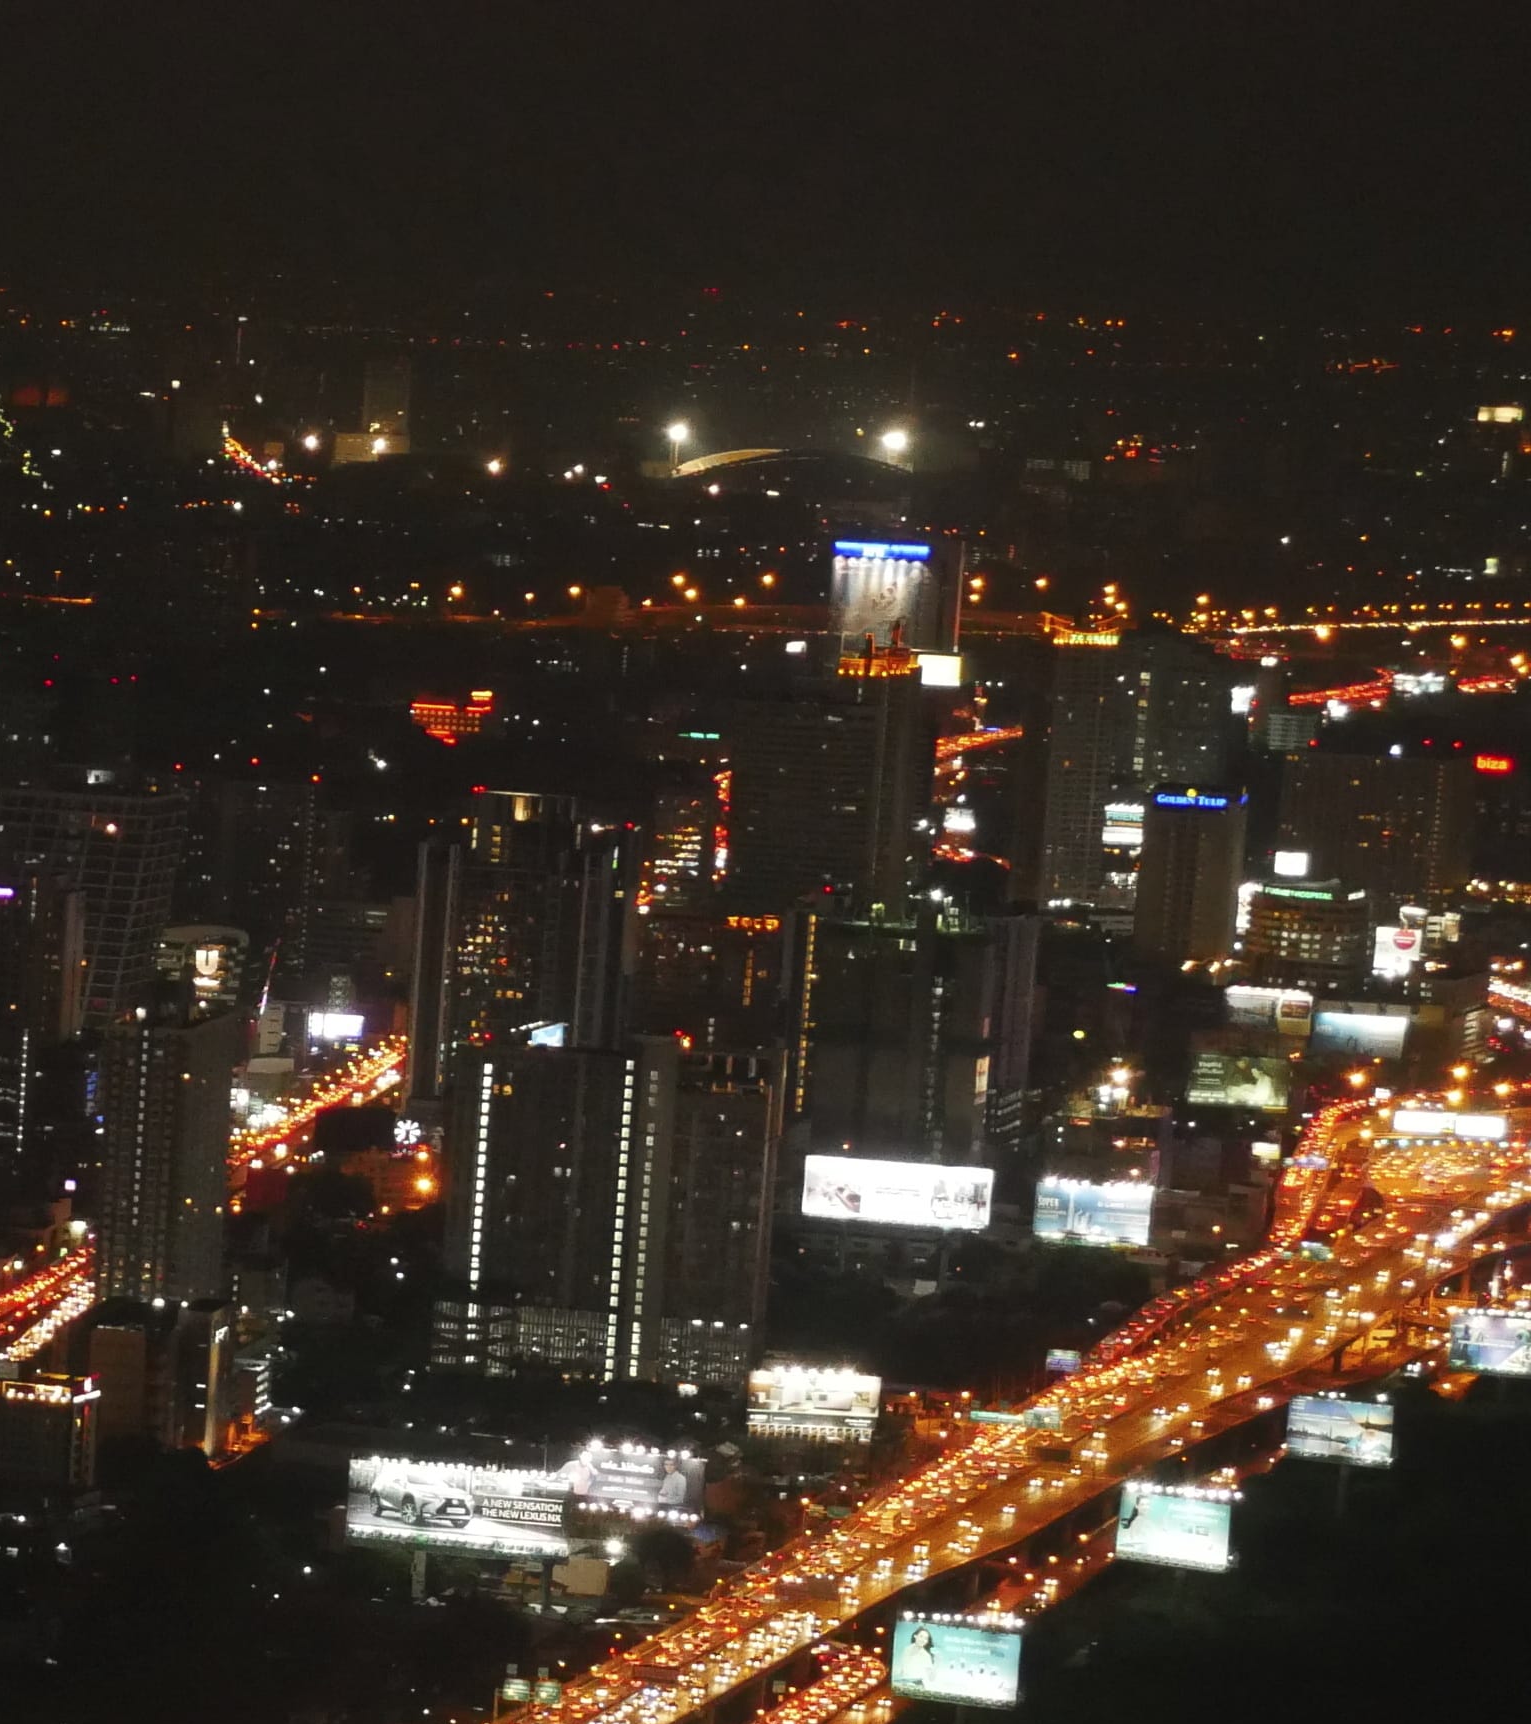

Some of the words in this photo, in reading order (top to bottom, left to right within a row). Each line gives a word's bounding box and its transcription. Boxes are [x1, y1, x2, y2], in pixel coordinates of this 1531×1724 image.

[1156, 794, 1196, 805] GOLDEN
[1198, 795, 1227, 806] TULIP
[482, 1498, 490, 1507] A
[490, 1499, 512, 1509] NEW
[513, 1501, 563, 1513] SENSATION
[482, 1508, 498, 1517] THE
[499, 1509, 519, 1519] NEW
[520, 1511, 547, 1521] LEXUS
[547, 1513, 562, 1522] NX
